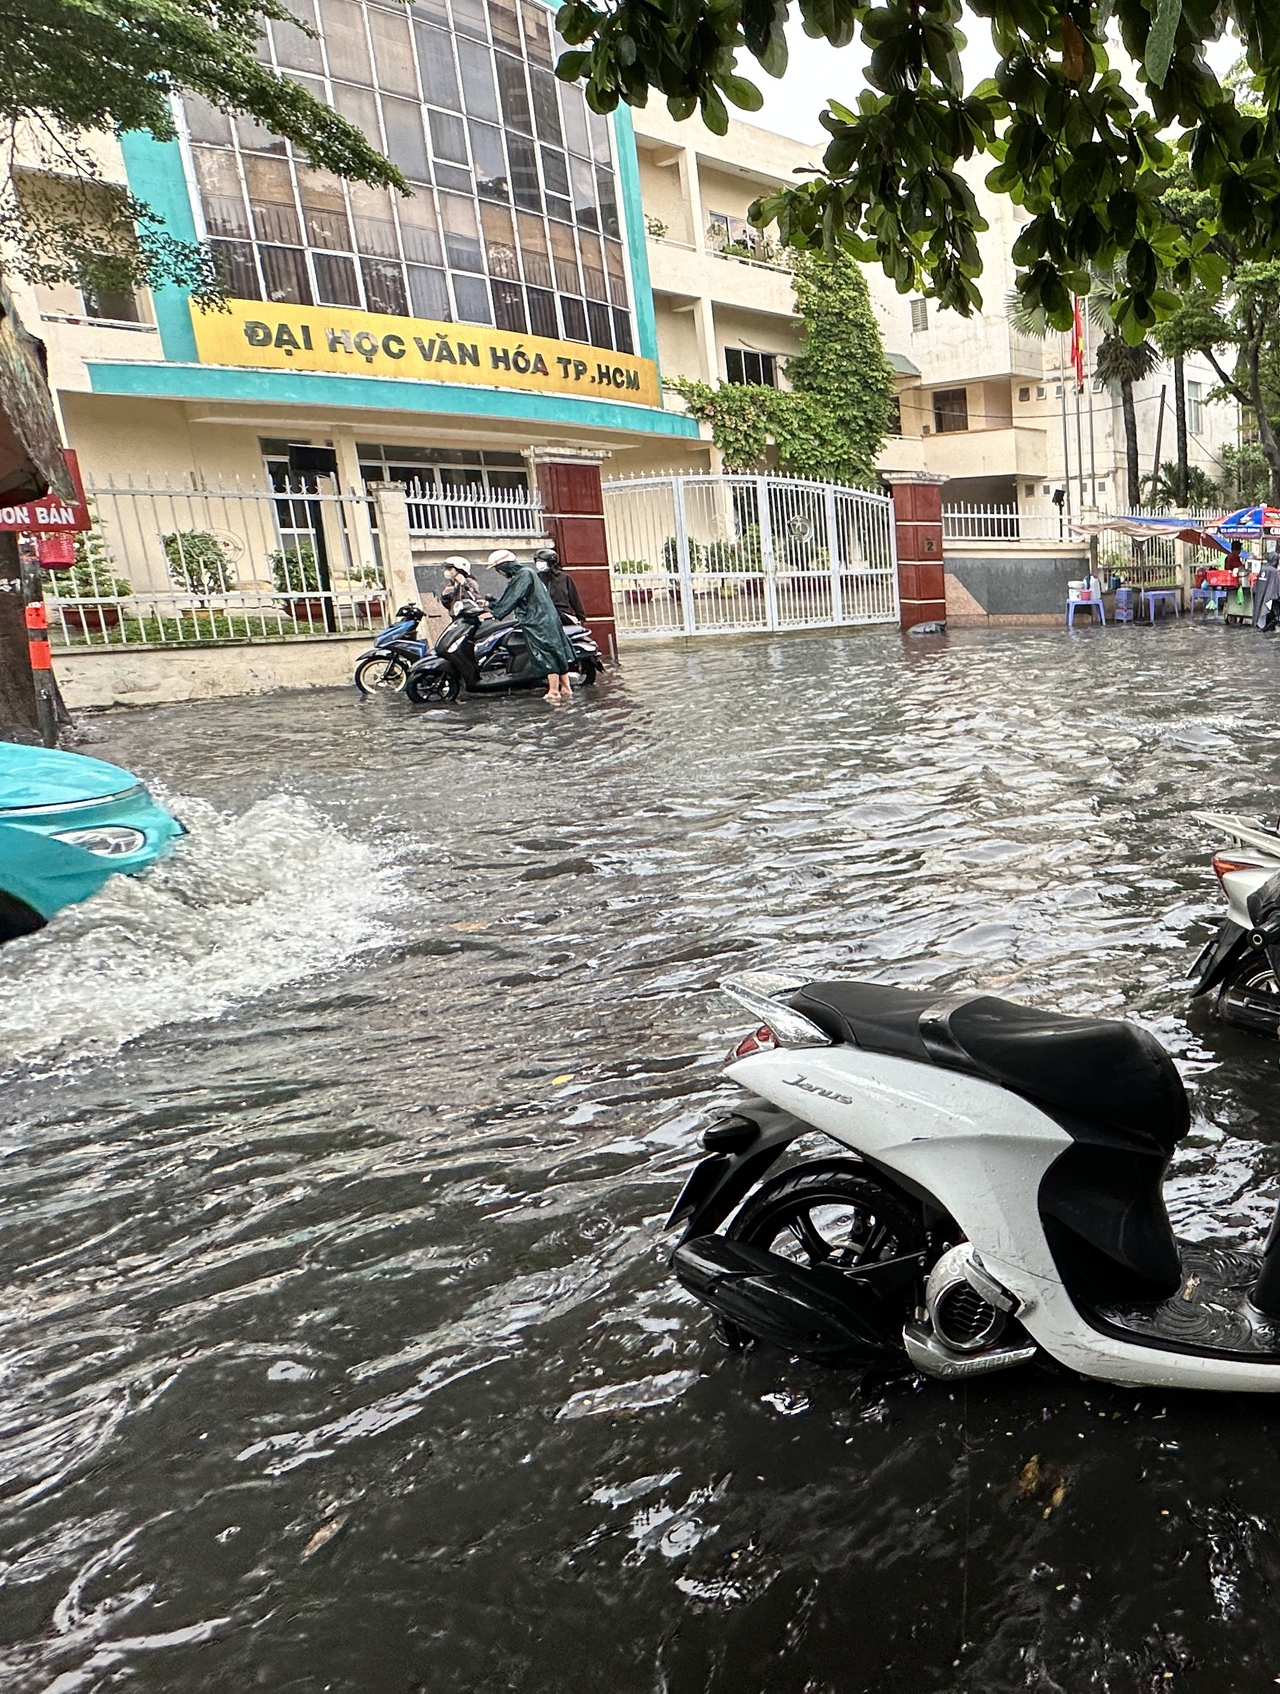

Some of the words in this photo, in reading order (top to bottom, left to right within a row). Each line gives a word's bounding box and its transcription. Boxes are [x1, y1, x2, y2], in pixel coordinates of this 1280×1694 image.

[244, 321, 314, 356] ĐẠI
[325, 327, 407, 363] HỌC
[413, 333, 480, 367] VĂN
[489, 344, 549, 376] HÓA
[35, 503, 76, 525] BÁN
[782, 1073, 853, 1105] Janus
